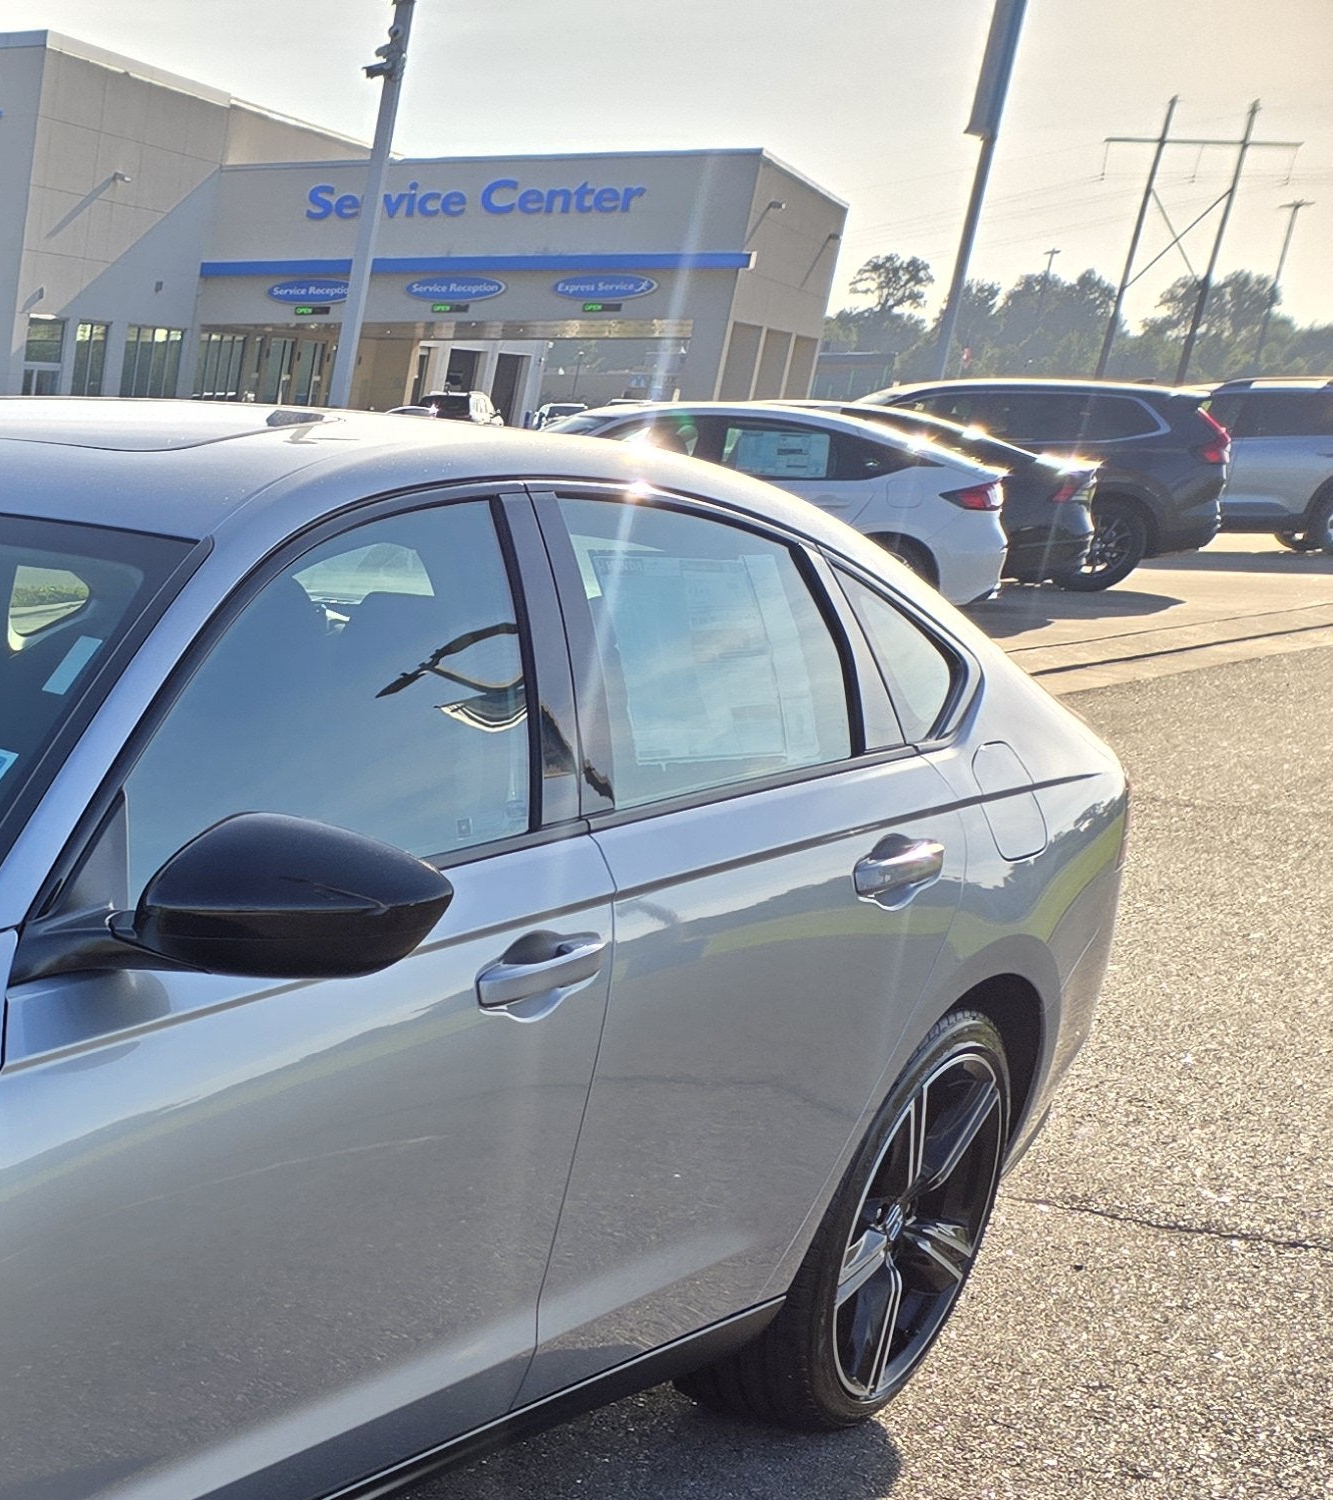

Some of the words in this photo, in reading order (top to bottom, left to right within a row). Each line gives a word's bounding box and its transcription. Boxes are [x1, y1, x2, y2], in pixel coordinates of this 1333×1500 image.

[306, 180, 467, 220] Sevice
[481, 178, 647, 215] Center
[272, 285, 306, 296] Service
[308, 285, 349, 296] Receptio
[411, 283, 446, 293] Service
[450, 282, 499, 293] Reception
[557, 282, 595, 293] Express
[597, 281, 634, 292] Service
